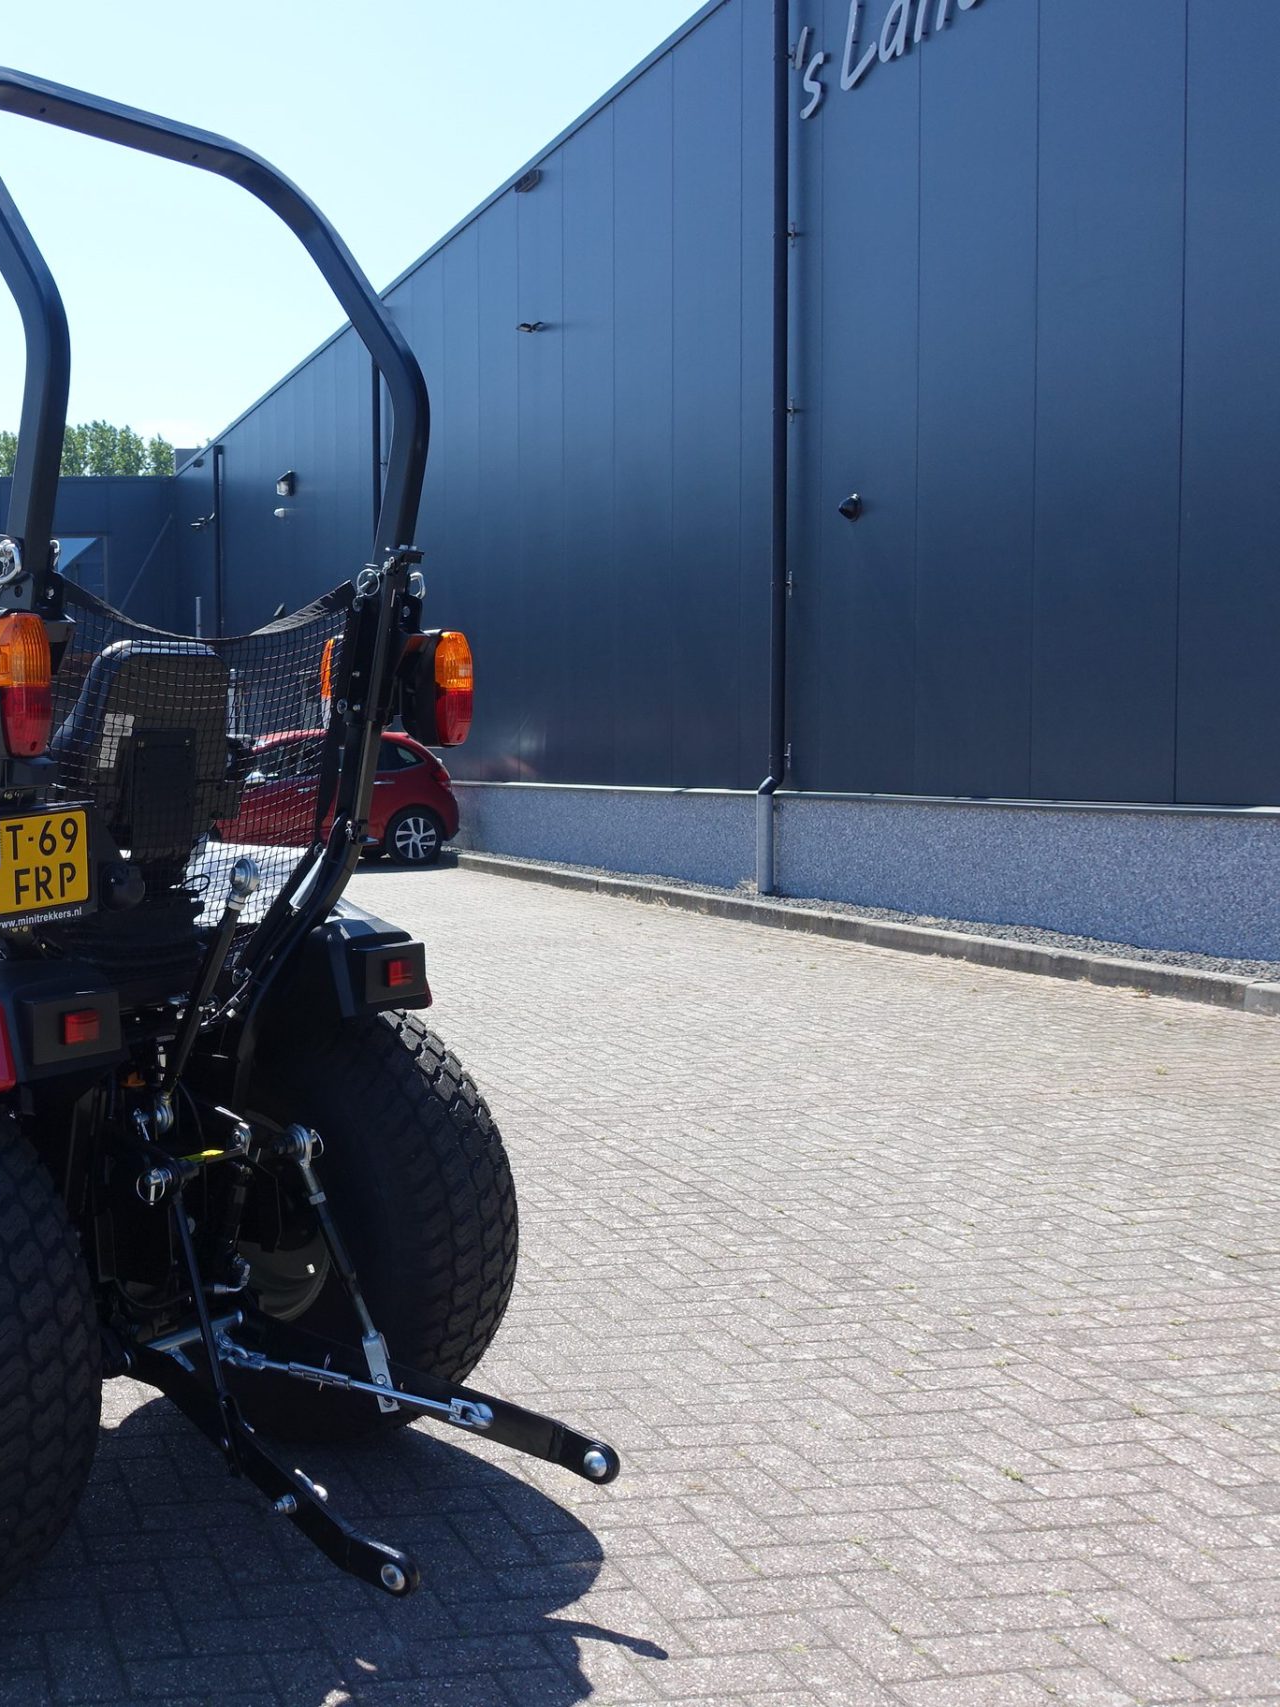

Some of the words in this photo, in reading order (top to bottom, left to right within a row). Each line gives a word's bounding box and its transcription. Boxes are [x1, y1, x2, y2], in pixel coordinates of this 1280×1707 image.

[840, 0, 977, 91] Lan
[6, 818, 79, 861] T-69
[14, 862, 77, 905] FRP
